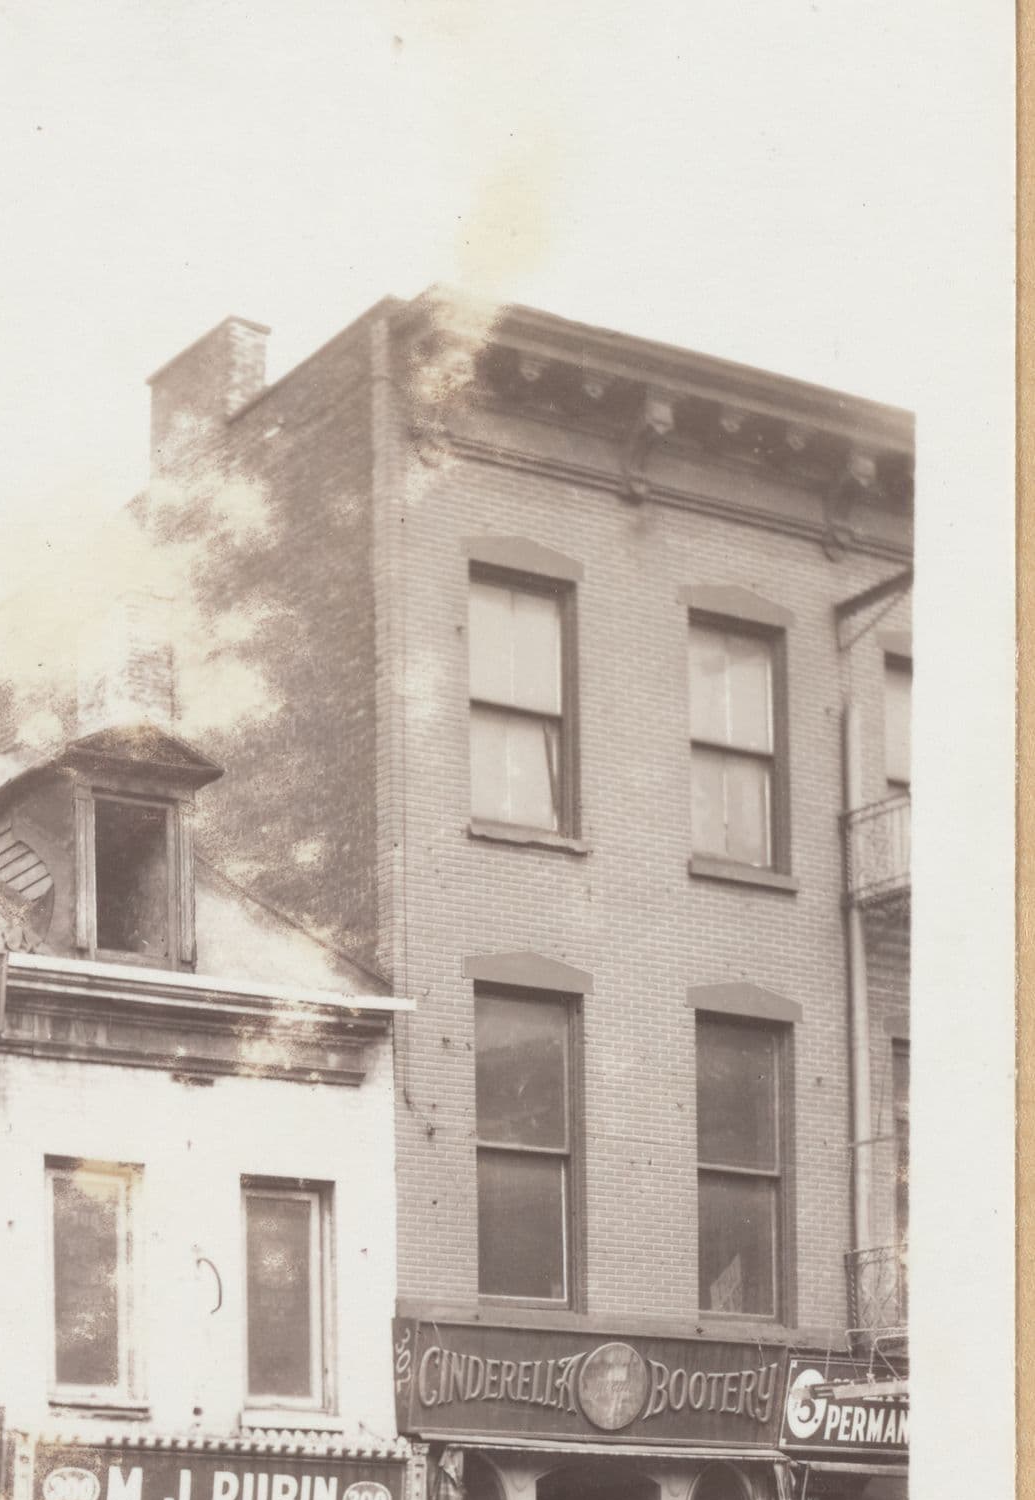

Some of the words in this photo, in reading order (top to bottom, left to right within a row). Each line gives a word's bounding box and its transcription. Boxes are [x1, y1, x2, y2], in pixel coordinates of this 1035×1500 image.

[395, 1327, 412, 1393] 302
[419, 1345, 588, 1416] CINDERELLA
[642, 1359, 779, 1423] BOOTERY
